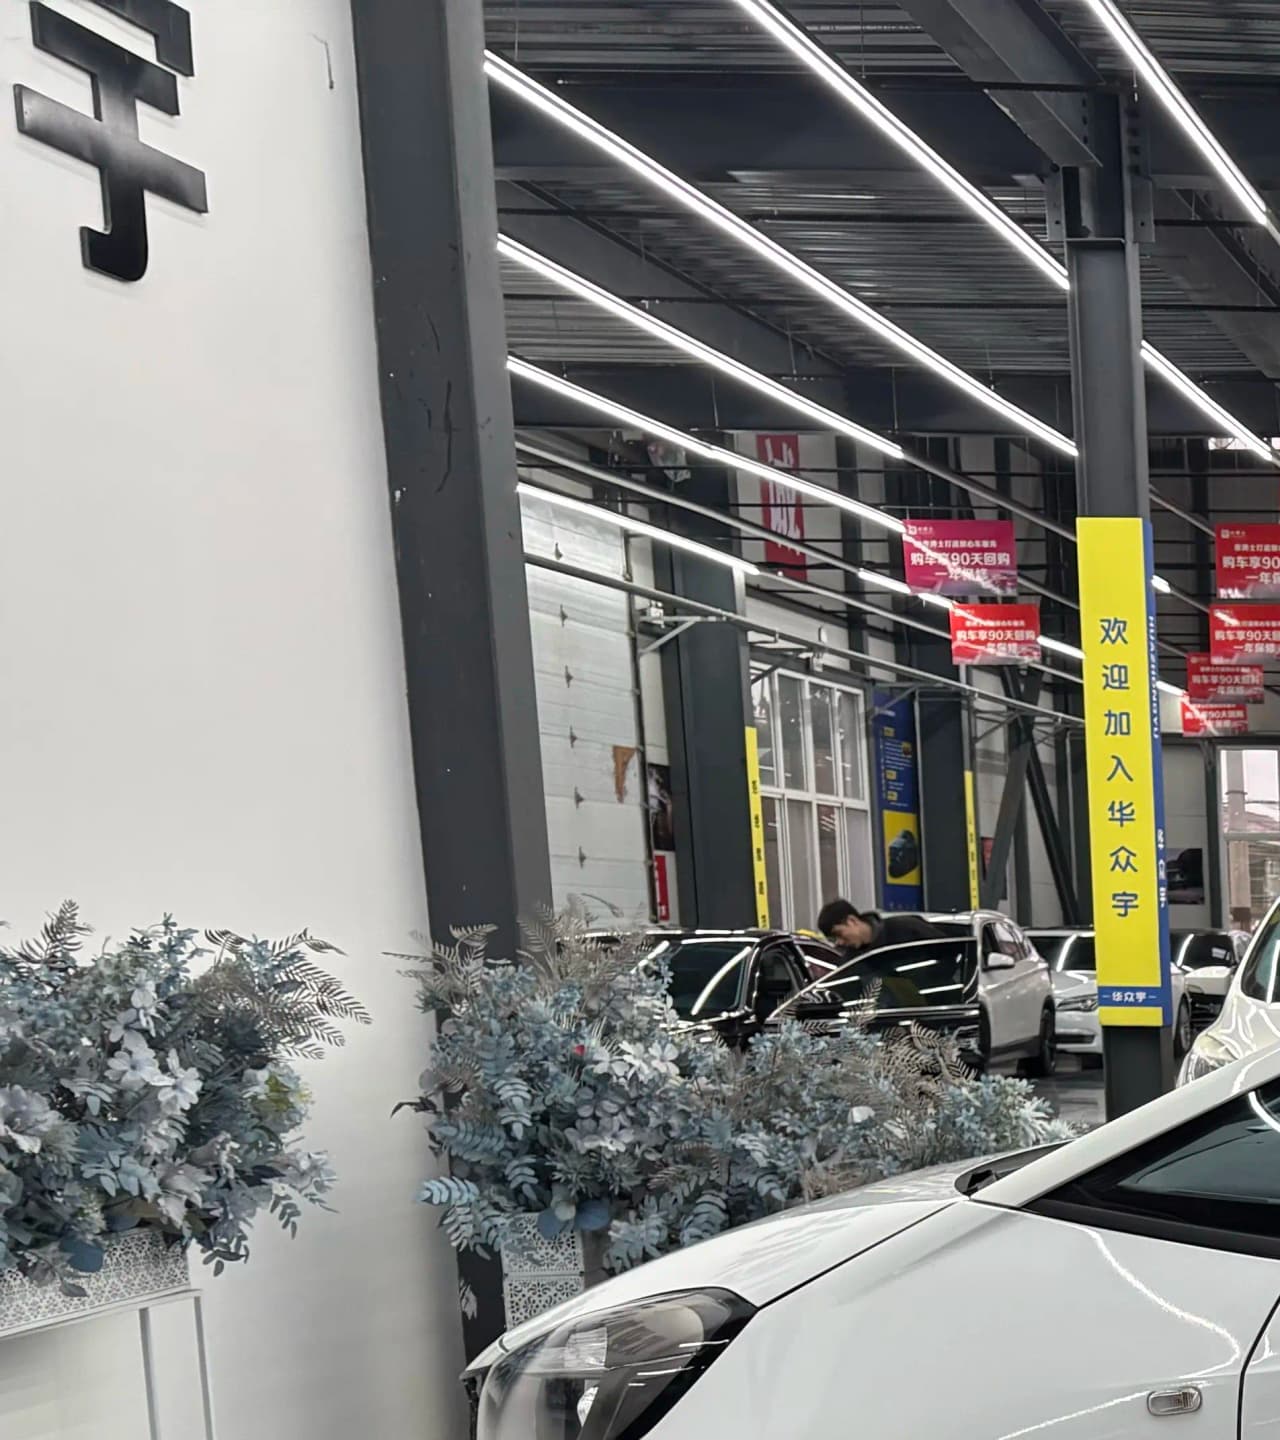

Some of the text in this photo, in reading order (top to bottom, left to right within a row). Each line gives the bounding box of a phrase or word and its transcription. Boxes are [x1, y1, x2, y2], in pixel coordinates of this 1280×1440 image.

[1099, 616, 1139, 918] 欢迎加入华众宇
[1112, 990, 1147, 1003] 华众宇
